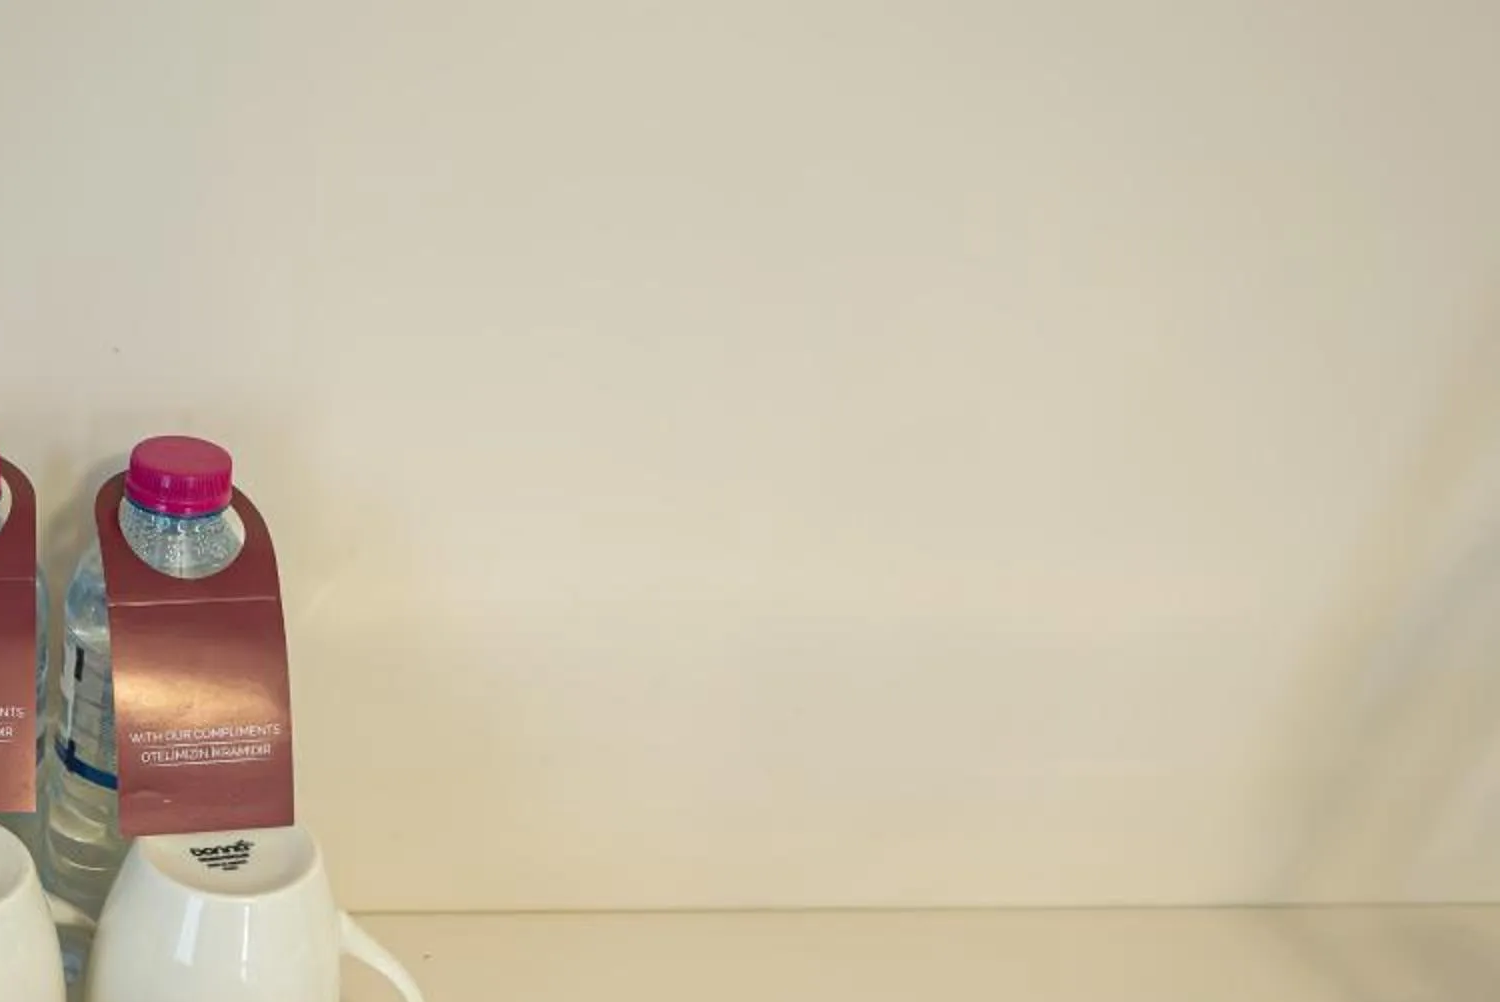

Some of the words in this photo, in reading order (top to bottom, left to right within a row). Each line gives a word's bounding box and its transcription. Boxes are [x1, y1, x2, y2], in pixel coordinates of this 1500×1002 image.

[129, 730, 163, 744] WITH
[164, 729, 191, 741] OUR
[194, 723, 281, 740] COMPLIMENTS
